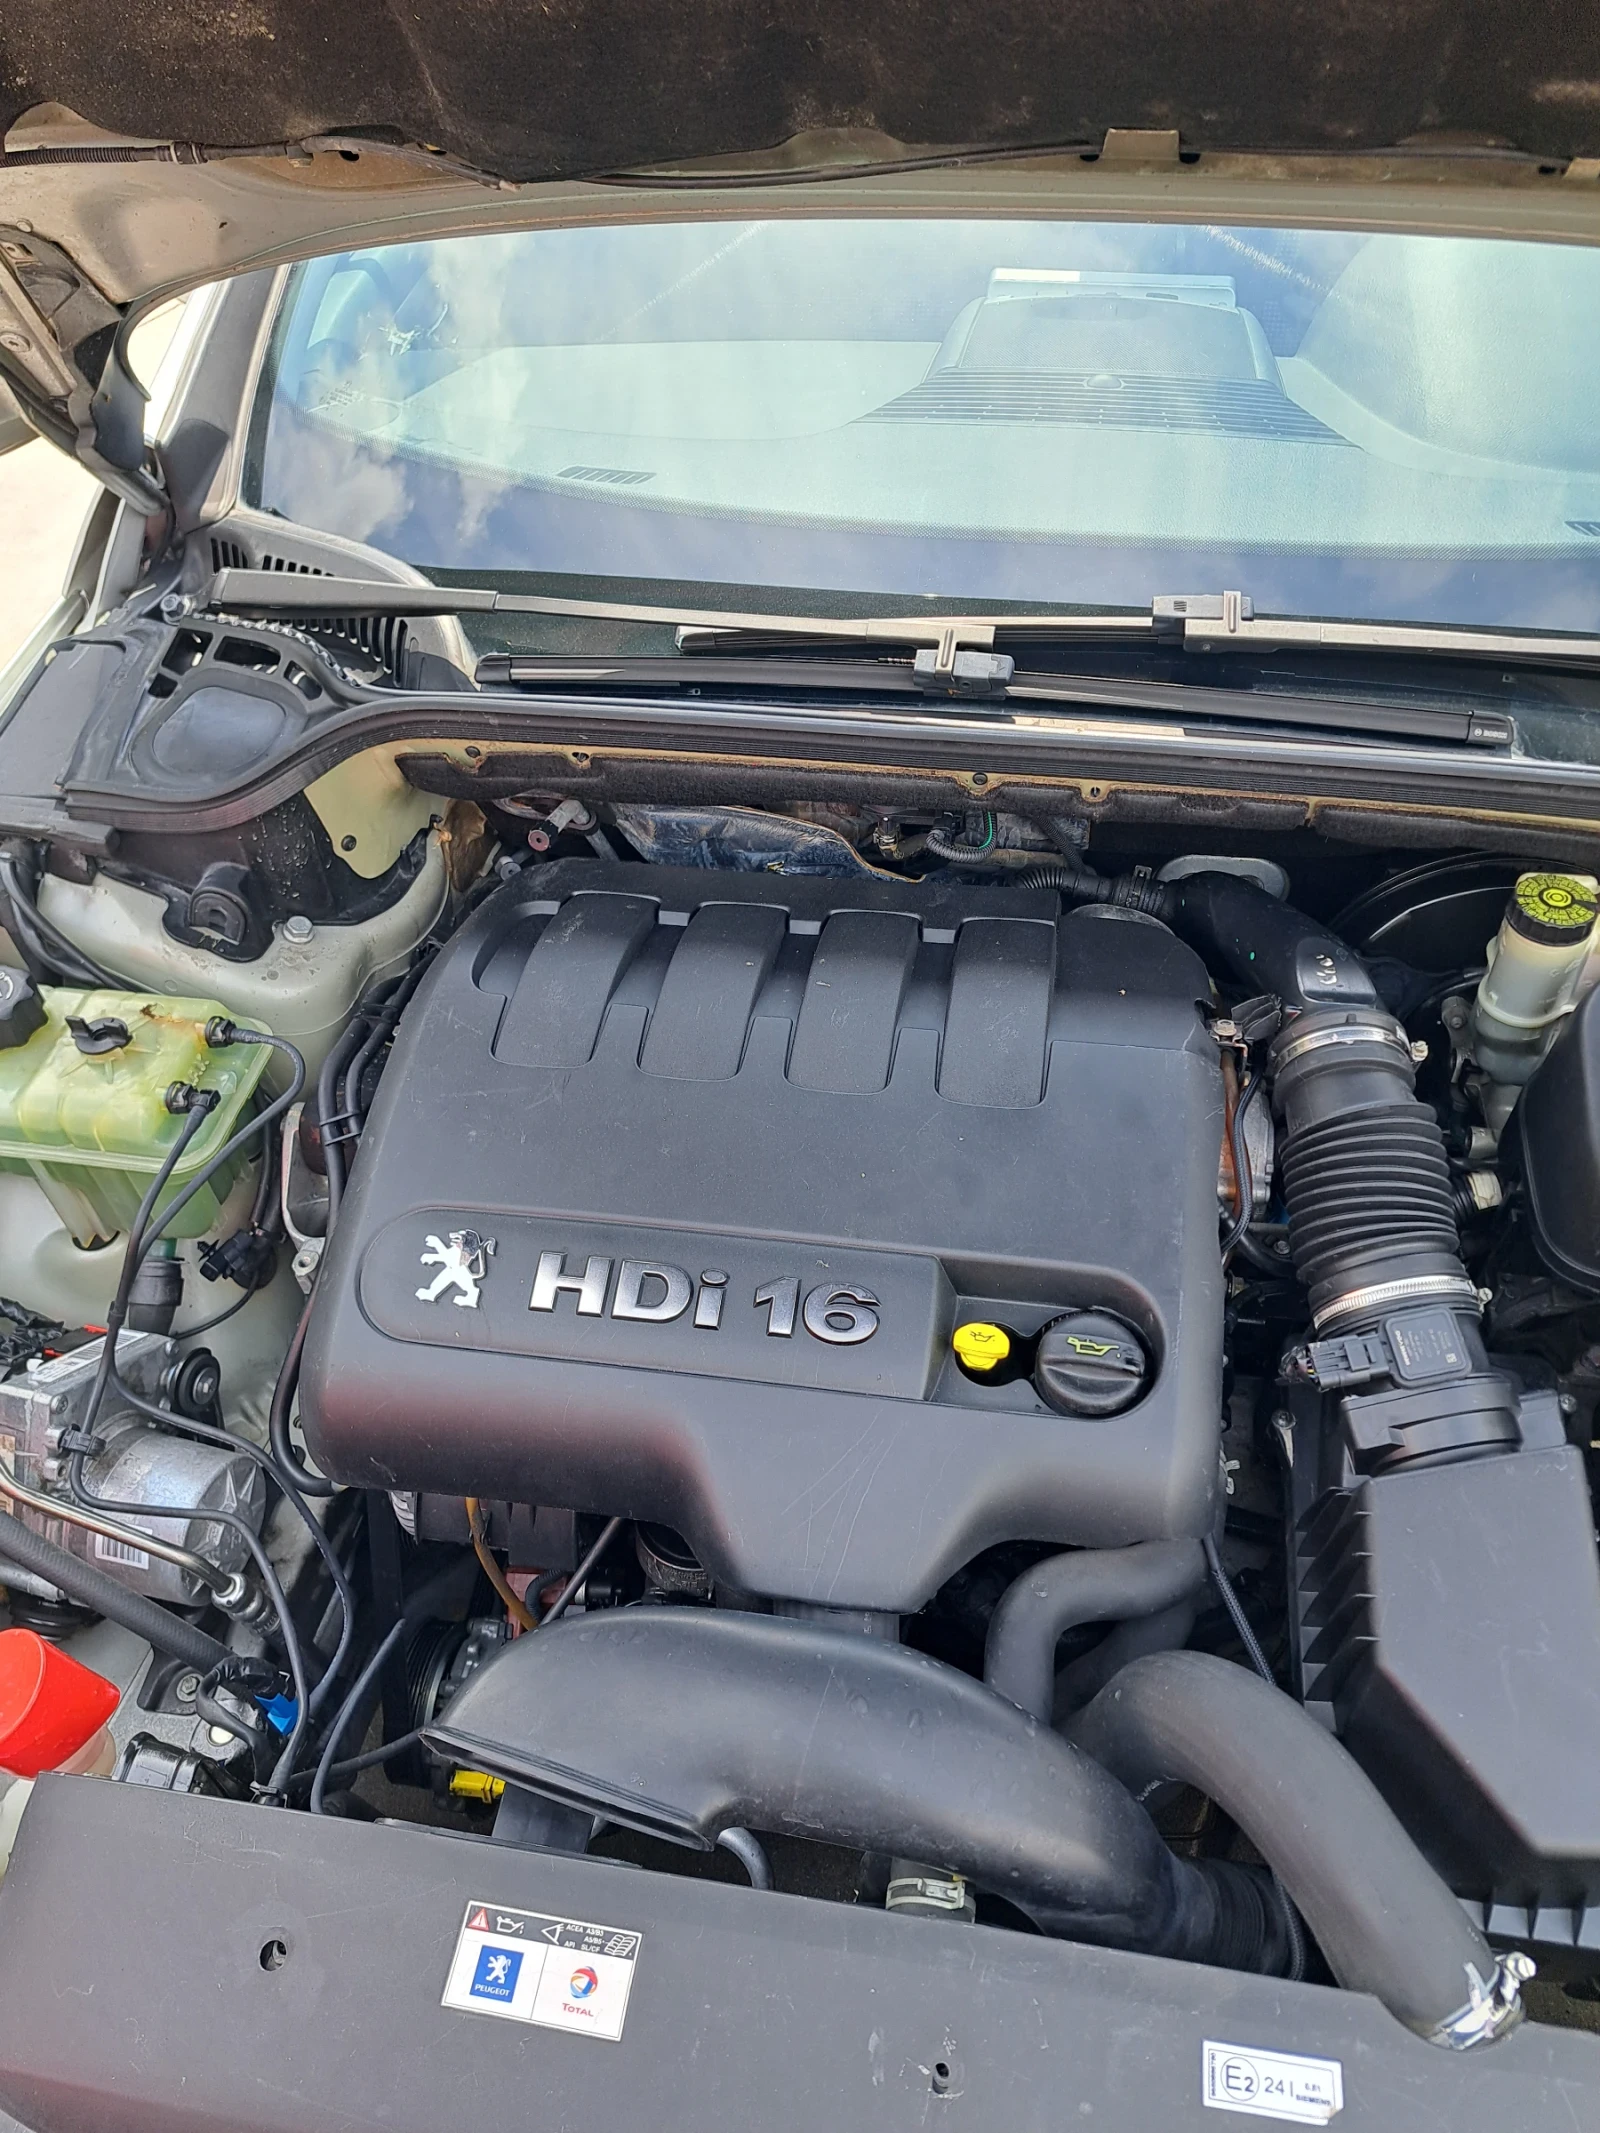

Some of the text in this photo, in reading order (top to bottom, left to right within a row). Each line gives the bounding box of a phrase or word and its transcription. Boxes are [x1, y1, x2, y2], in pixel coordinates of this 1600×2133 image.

[528, 1250, 882, 1347] HDi 16
[566, 1924, 584, 1933] ACEA
[564, 1940, 576, 1948] API
[474, 1983, 510, 1997] PEUGEOT
[1226, 2064, 1254, 2093] E2
